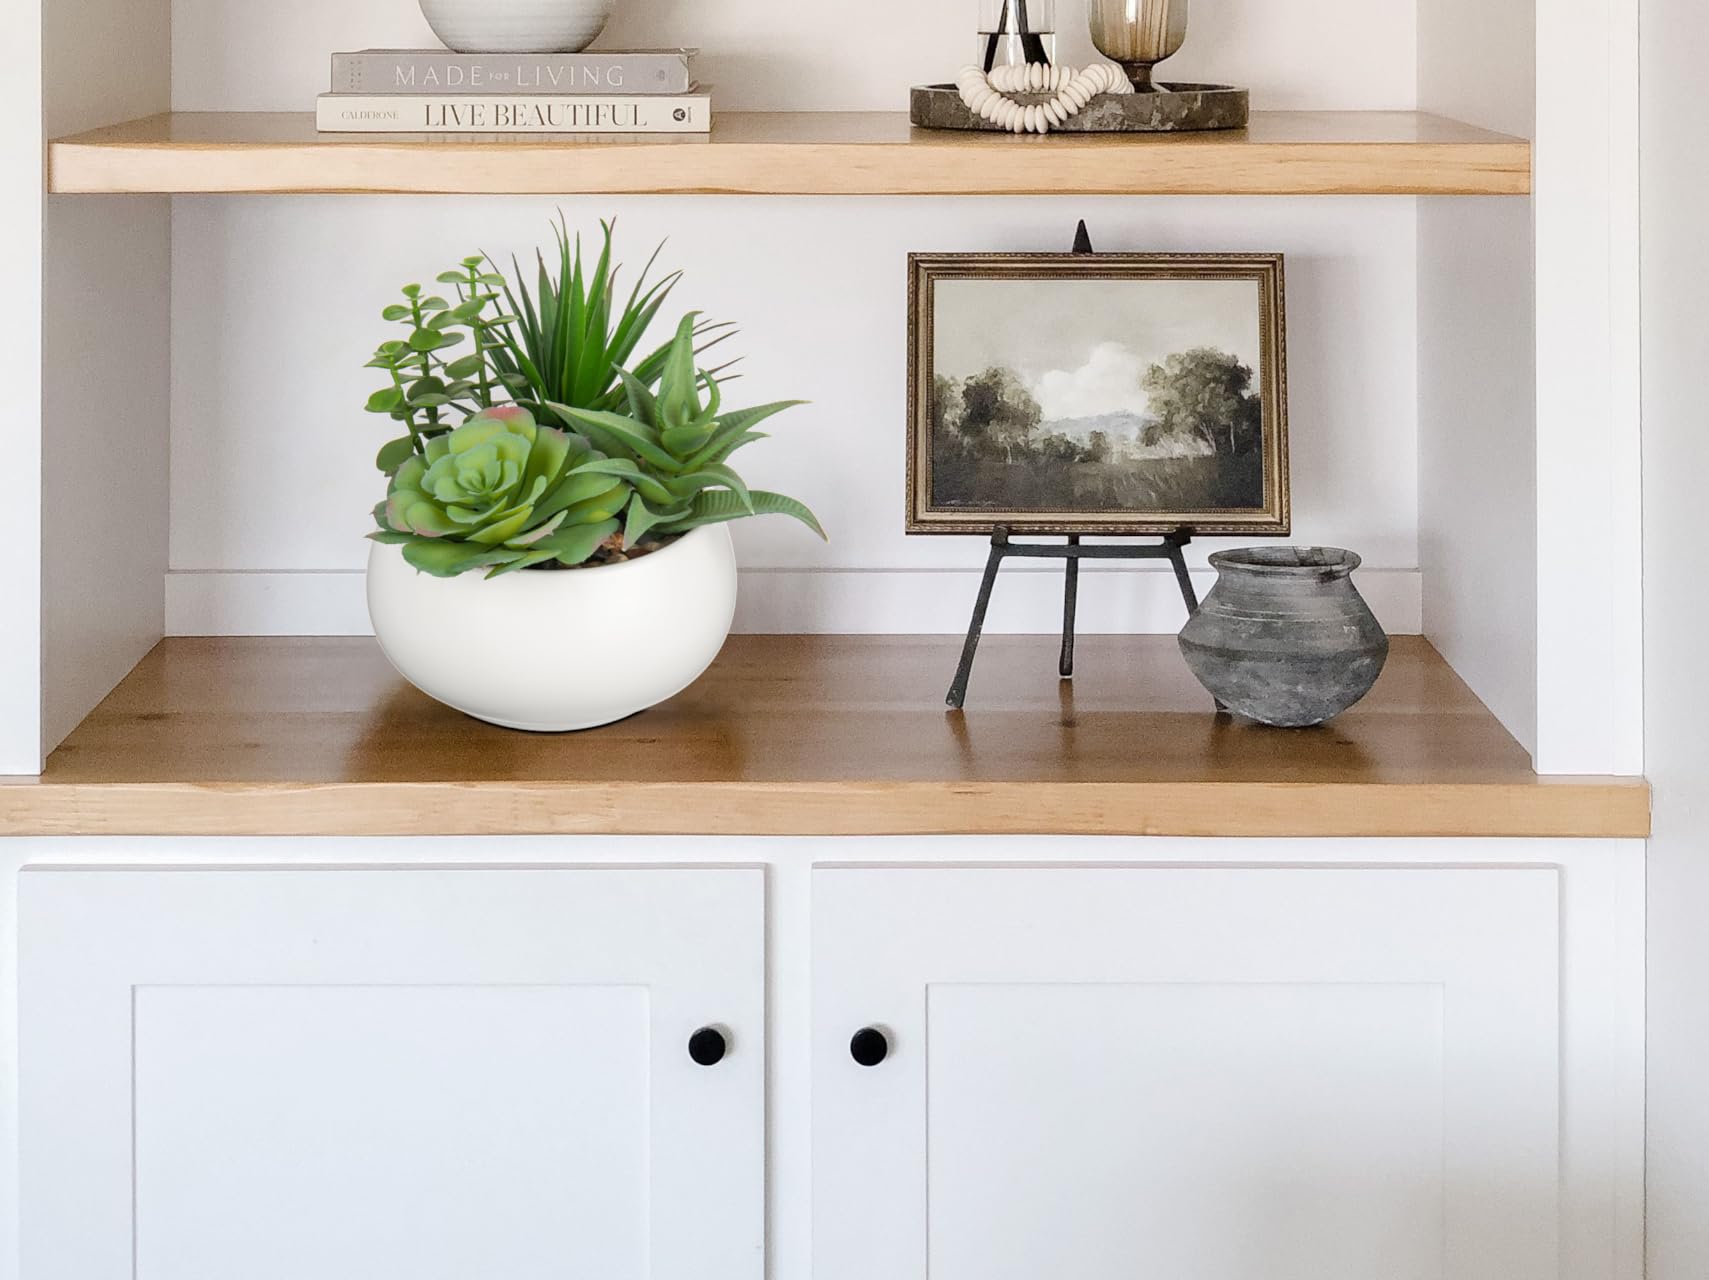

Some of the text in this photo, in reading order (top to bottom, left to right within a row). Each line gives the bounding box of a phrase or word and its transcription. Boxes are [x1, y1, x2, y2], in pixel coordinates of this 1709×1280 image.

[395, 65, 624, 86] MADE FOR LIVING
[341, 111, 399, 120] CALDERONE
[424, 104, 647, 126] LIVE BEAUTIFUL
